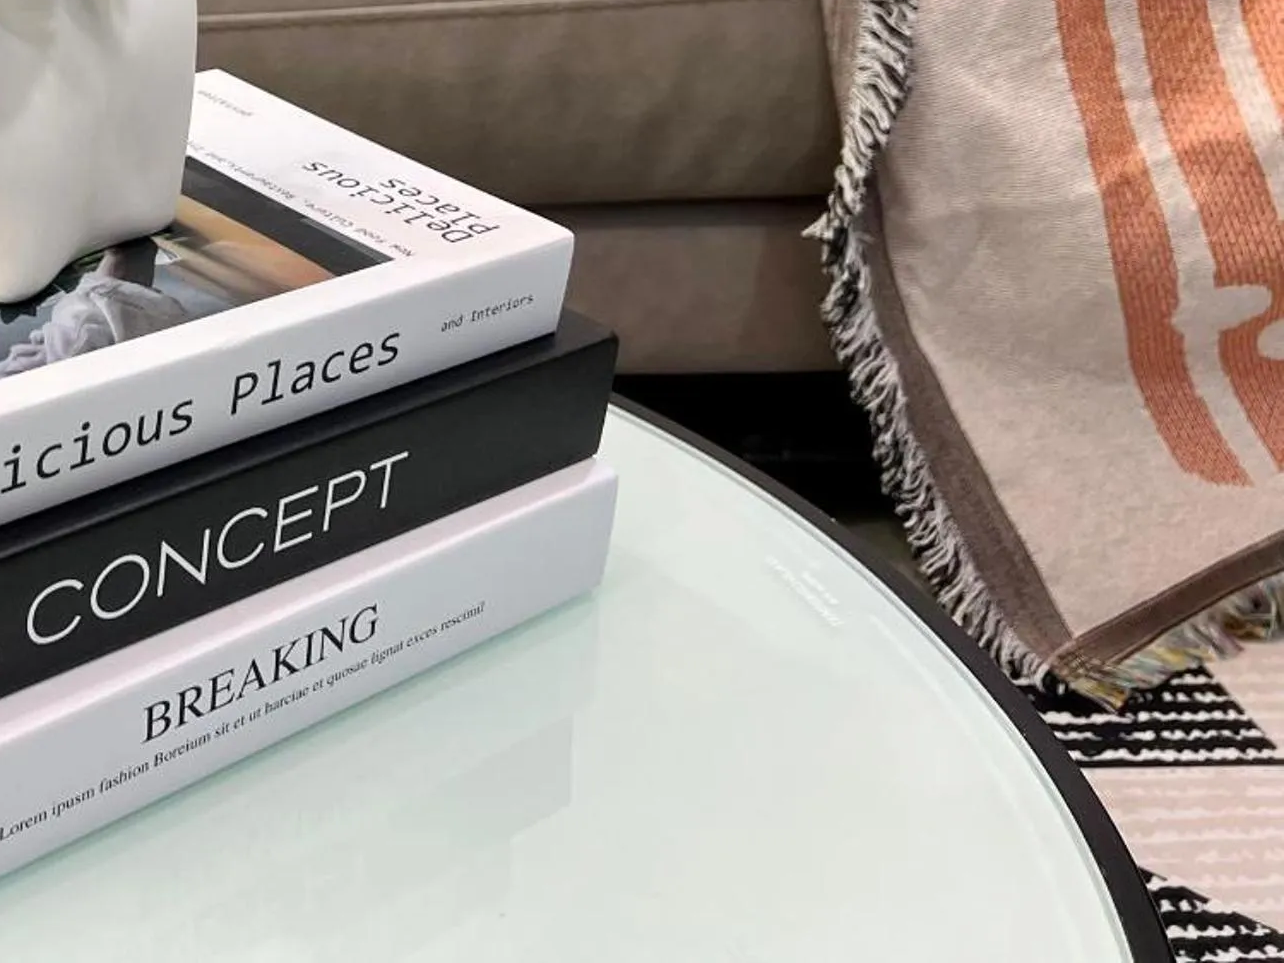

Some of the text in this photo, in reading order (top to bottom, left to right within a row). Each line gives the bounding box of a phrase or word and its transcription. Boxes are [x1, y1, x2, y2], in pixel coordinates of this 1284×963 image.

[302, 161, 473, 243] Delicious
[380, 177, 500, 235] Places
[441, 293, 534, 333] and Interiors
[229, 331, 401, 415] Places
[25, 451, 409, 645] CONCEPT
[142, 603, 380, 744] BREAKING
[0, 810, 48, 841] Lorem
[51, 787, 96, 818] ipusm
[99, 760, 150, 794] fashion
[153, 732, 212, 768] Boreium
[214, 721, 231, 738] sit
[233, 714, 245, 731] et
[249, 707, 262, 722] ut
[312, 678, 324, 693] et
